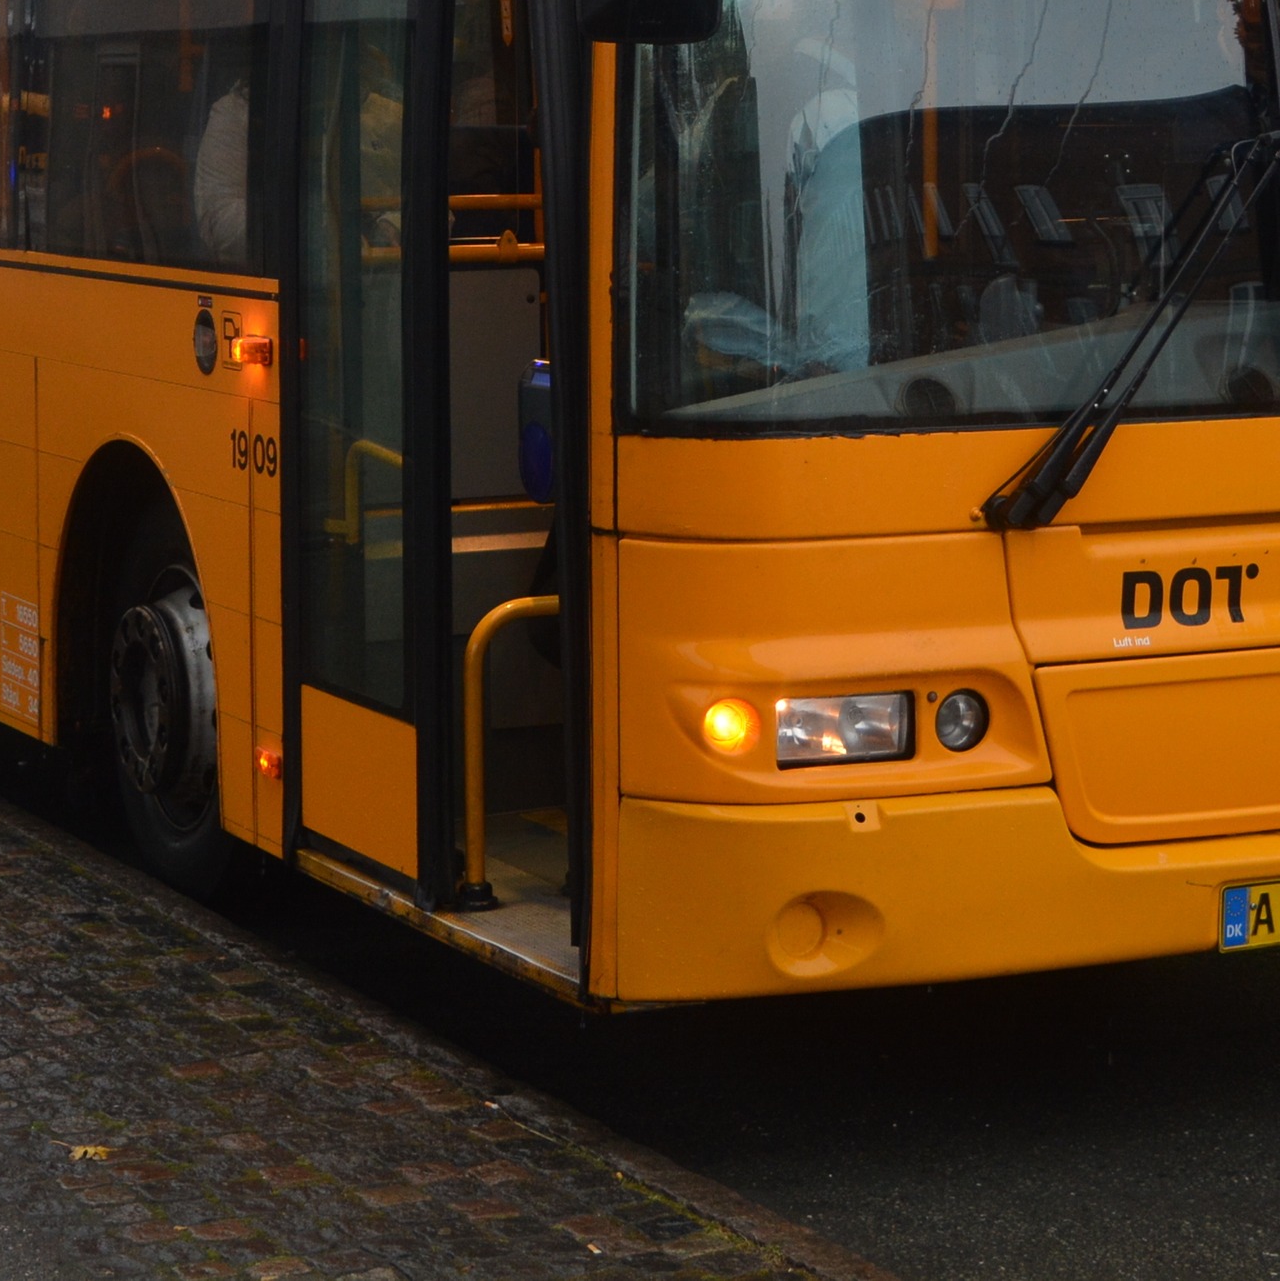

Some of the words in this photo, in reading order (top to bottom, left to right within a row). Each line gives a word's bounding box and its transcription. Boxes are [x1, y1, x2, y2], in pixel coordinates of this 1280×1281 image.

[230, 428, 278, 479] 1909
[1121, 563, 1260, 630] DOT
[1113, 636, 1134, 648] Luft
[1134, 635, 1151, 646] ind
[1226, 923, 1243, 939] DK
